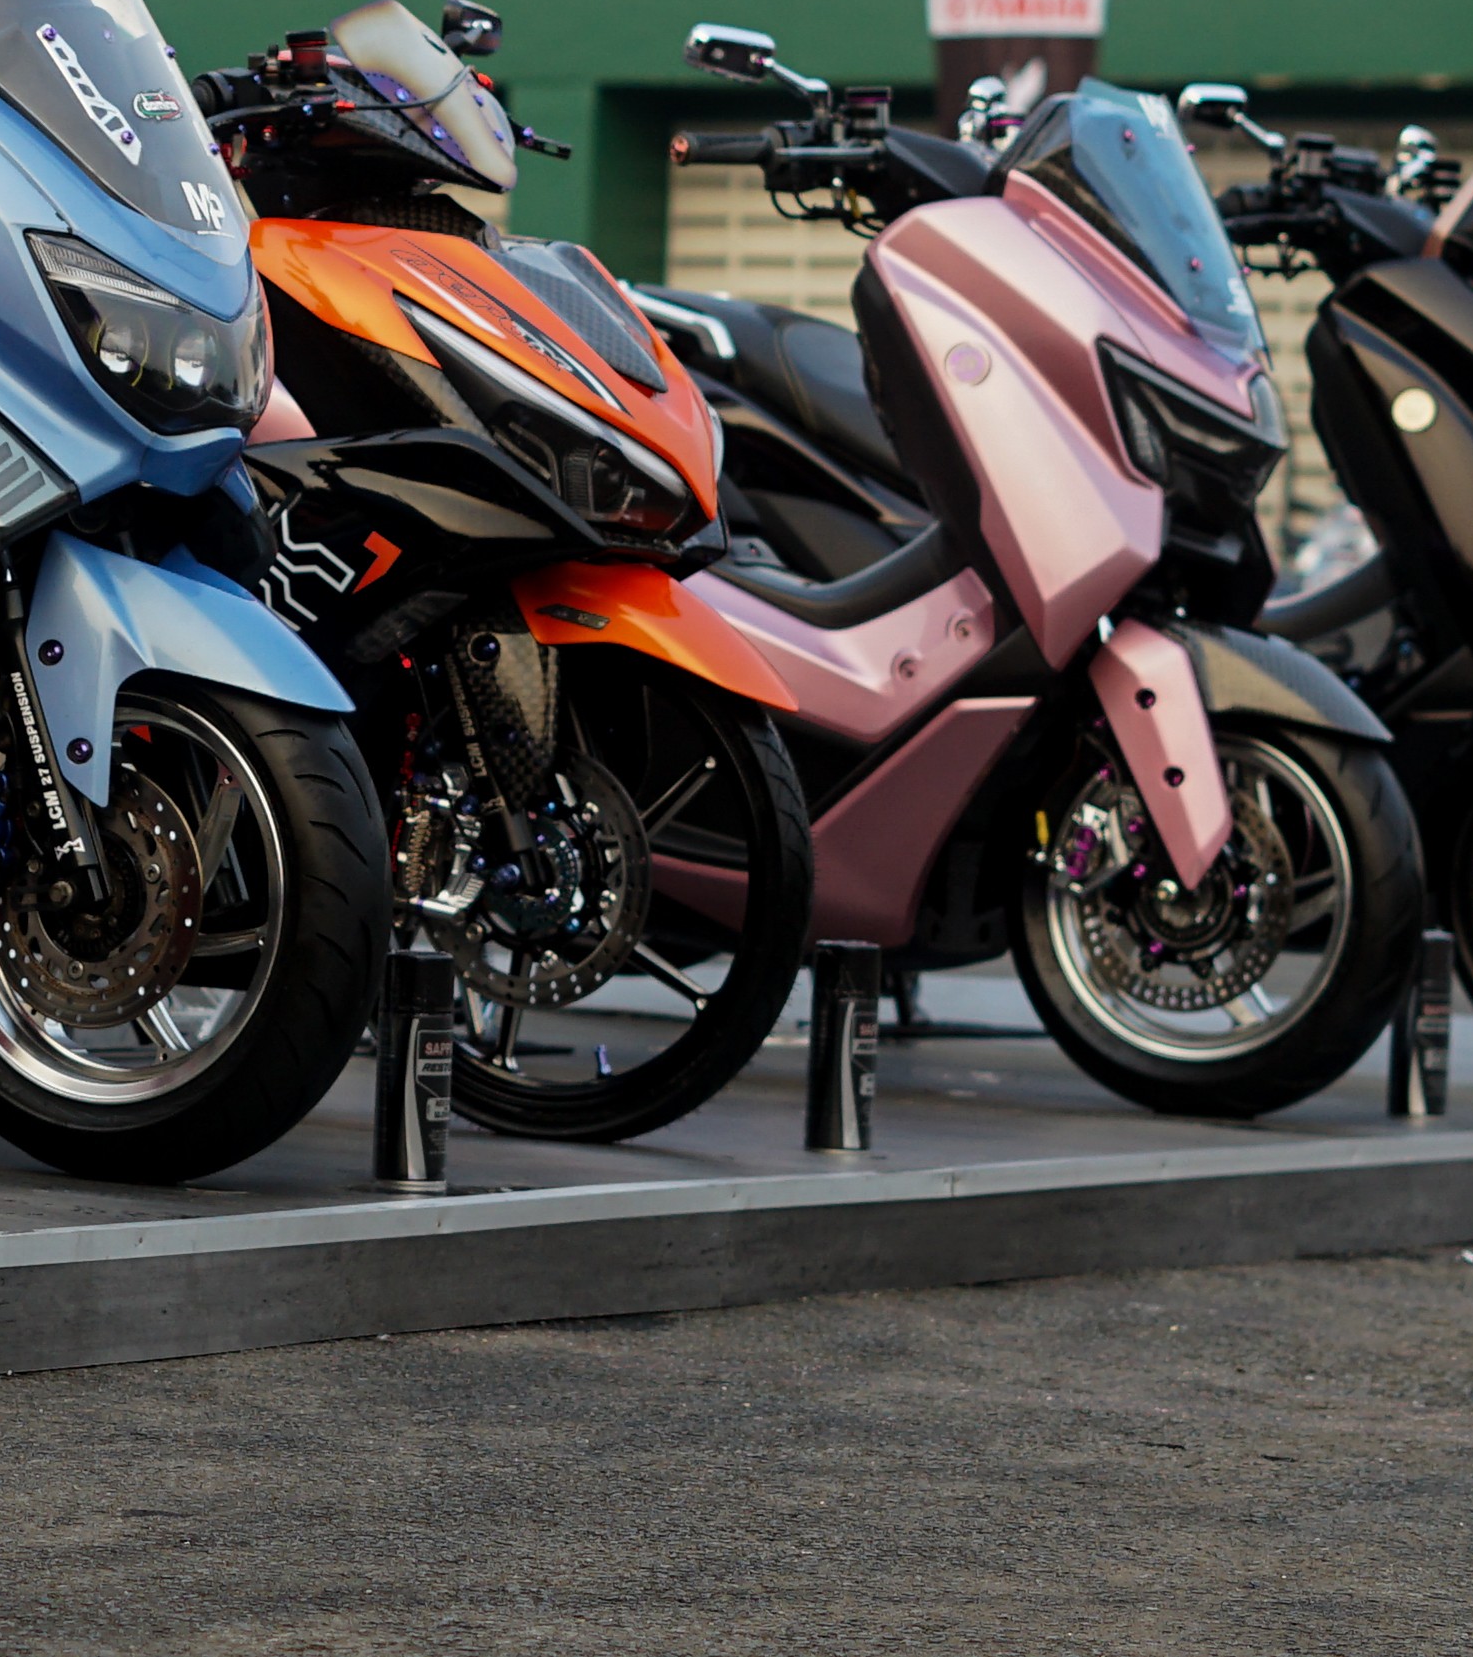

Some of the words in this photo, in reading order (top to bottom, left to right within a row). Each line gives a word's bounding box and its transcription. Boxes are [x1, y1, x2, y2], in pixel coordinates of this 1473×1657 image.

[10, 670, 47, 765] SUSPENSION
[36, 766, 54, 787] 27
[42, 788, 68, 831] LCM
